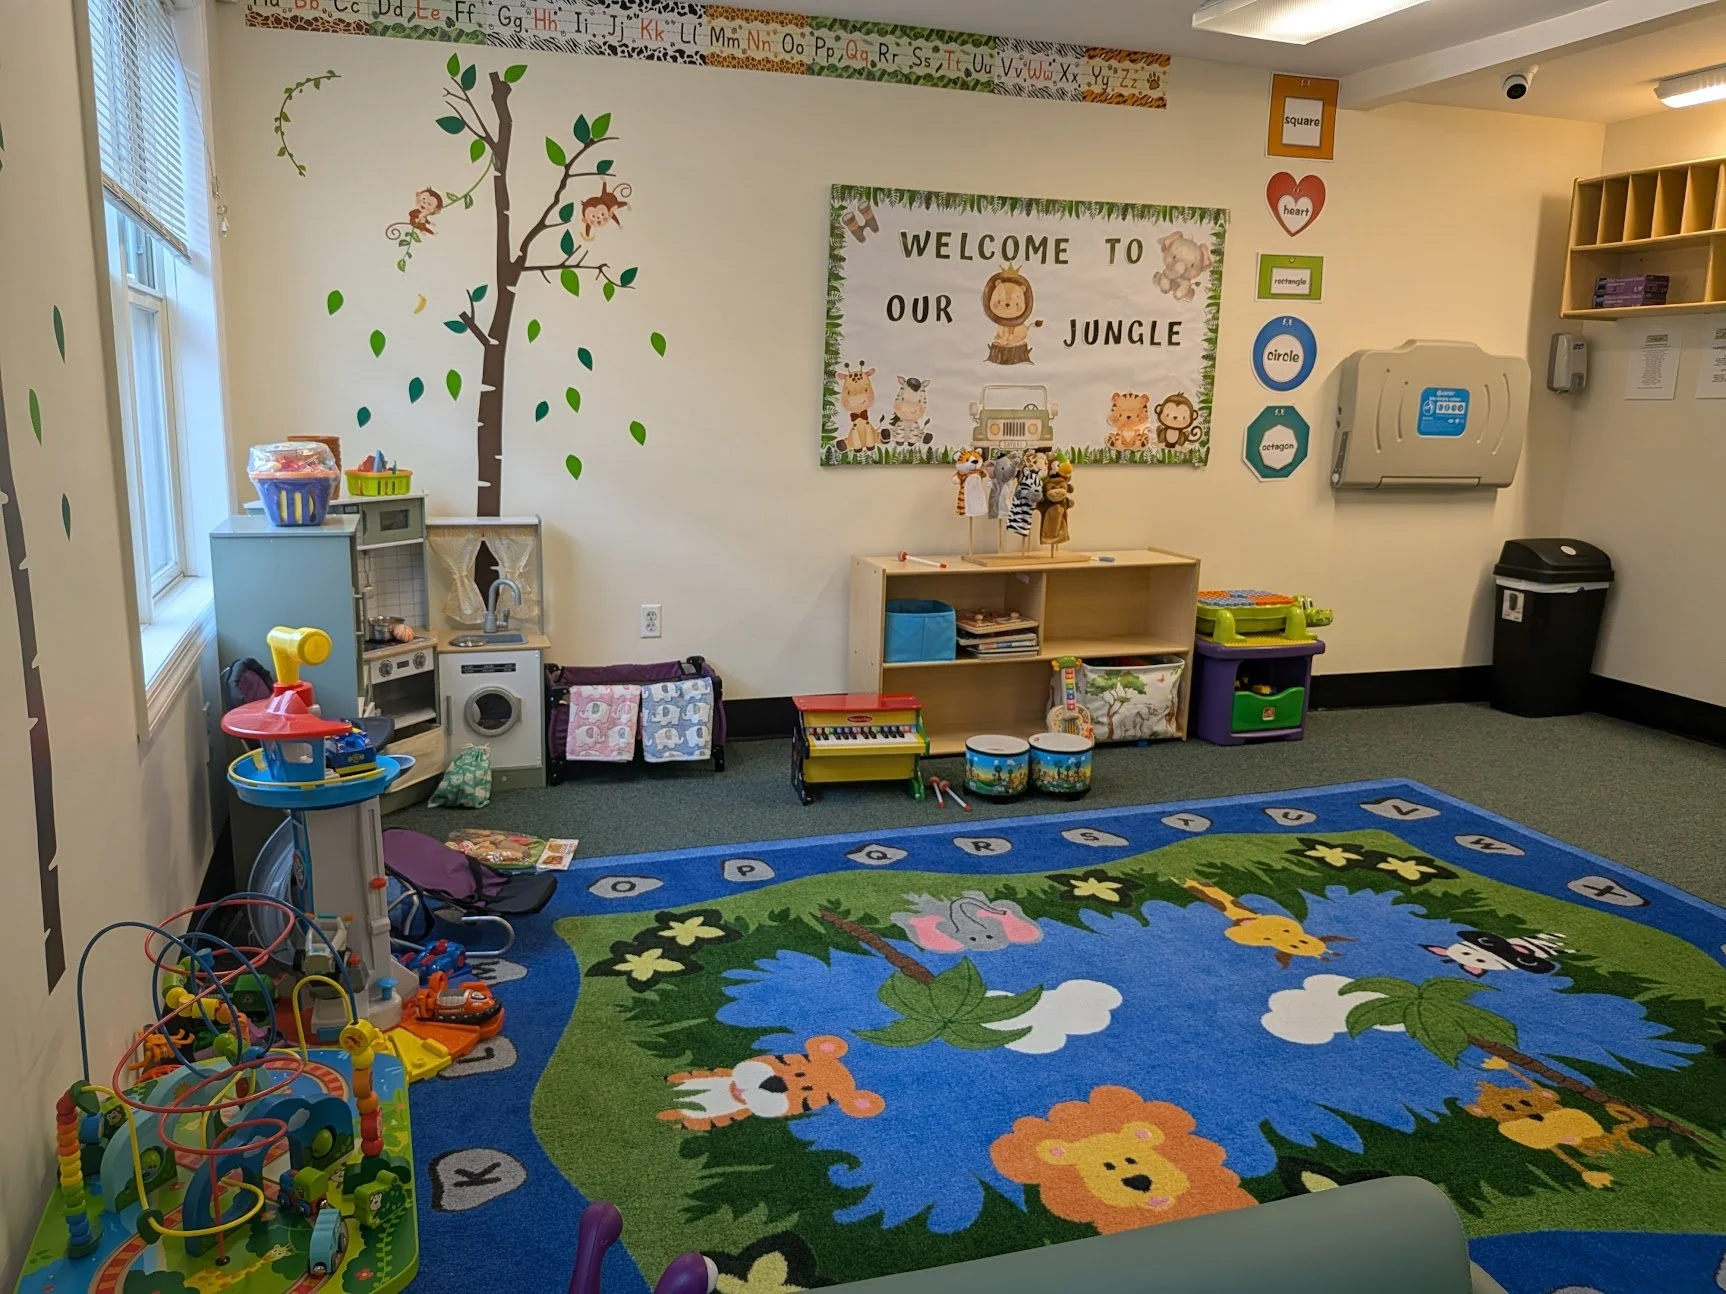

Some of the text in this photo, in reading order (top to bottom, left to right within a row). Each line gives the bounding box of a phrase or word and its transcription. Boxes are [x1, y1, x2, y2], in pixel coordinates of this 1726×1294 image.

[333, 0, 360, 13] Cc
[378, 0, 403, 17] Dd
[416, 0, 440, 20] Ee
[455, 1, 476, 23] Ff
[497, 5, 523, 33] Gg
[534, 8, 557, 31] Hh
[574, 12, 588, 33] Ii
[608, 15, 624, 42] Jj
[640, 18, 665, 41] Kk
[680, 22, 697, 44] Ll
[710, 26, 740, 49] Mm
[747, 29, 771, 51] Nn
[782, 33, 804, 55] Oo
[815, 37, 835, 63] Pp
[846, 39, 869, 69] Qq
[879, 42, 899, 64] Rr
[912, 47, 931, 68] Ss
[944, 49, 962, 72] Tt
[972, 53, 992, 74] Uu
[1001, 57, 1022, 78] Vv
[1027, 59, 1053, 81] Ww
[1060, 62, 1078, 83] Xx
[1091, 65, 1109, 90] Yy
[1120, 69, 1137, 89] Zz
[1284, 115, 1321, 128] square
[1283, 204, 1310, 217] heart
[900, 230, 1144, 265] WELCOME TO
[1273, 276, 1307, 288] rectangle
[886, 294, 953, 323] OUR
[1062, 319, 1183, 348] JUNGLE
[1267, 349, 1300, 363] circle
[1261, 443, 1295, 453] octagon
[611, 880, 637, 893] O
[736, 864, 756, 876] P
[865, 850, 889, 861] Q
[972, 840, 994, 851] R
[1080, 831, 1100, 841] S
[1282, 811, 1304, 821] U
[1391, 804, 1420, 816] V
[1470, 837, 1628, 898] W X
[459, 1047, 495, 1064] L
[453, 1161, 502, 1187] K
